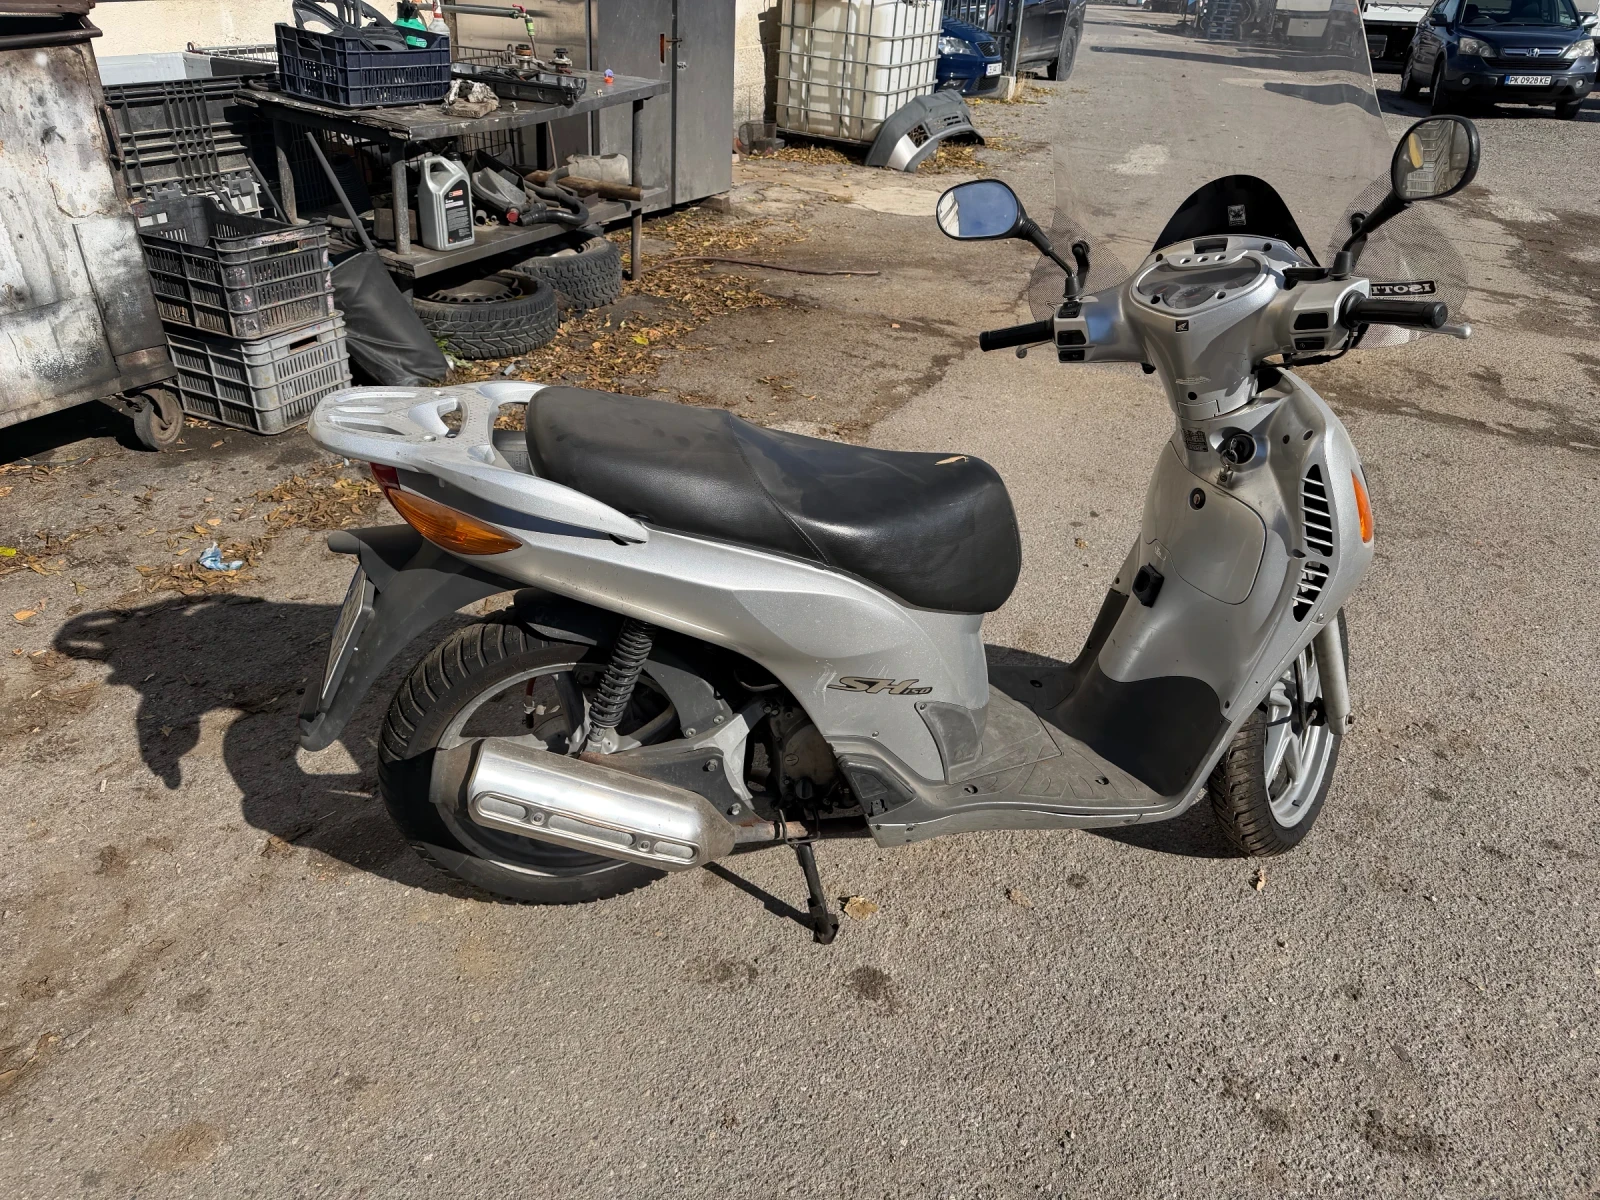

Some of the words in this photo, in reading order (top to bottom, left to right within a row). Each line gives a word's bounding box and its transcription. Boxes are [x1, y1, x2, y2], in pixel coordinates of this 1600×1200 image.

[1510, 76, 1519, 84] PK
[1520, 76, 1539, 85] 0928
[1540, 76, 1550, 85] KE
